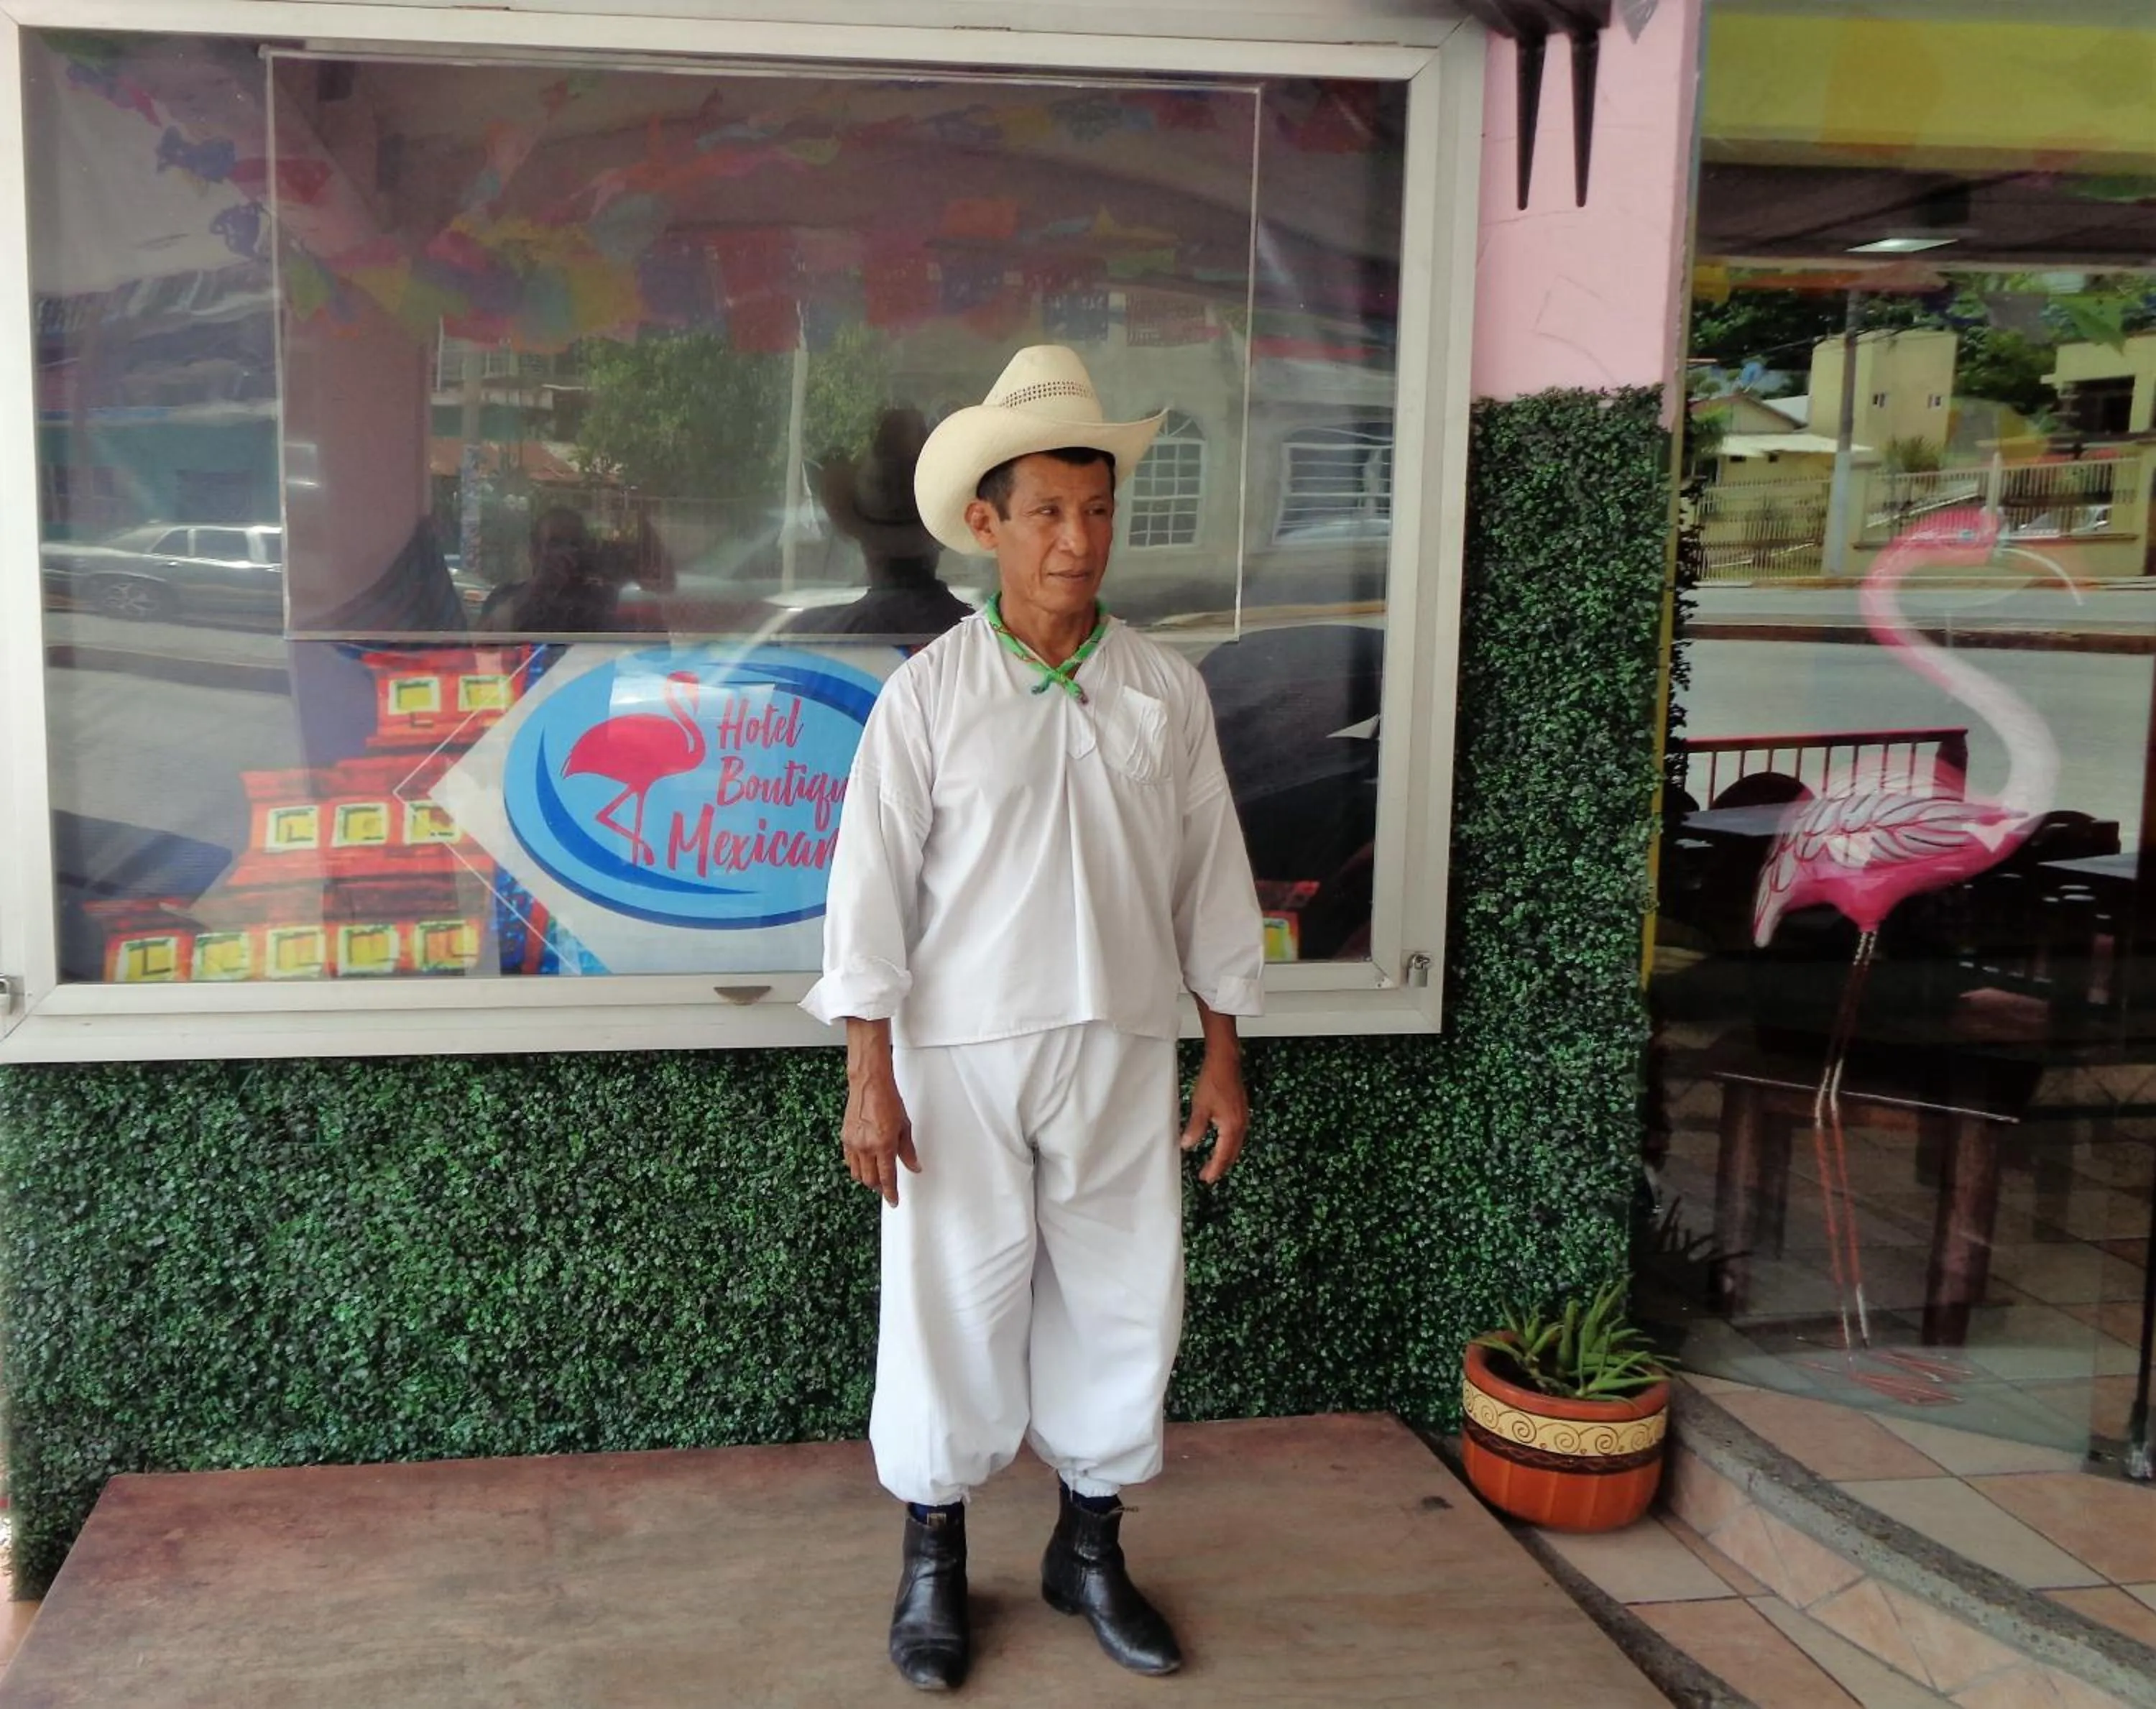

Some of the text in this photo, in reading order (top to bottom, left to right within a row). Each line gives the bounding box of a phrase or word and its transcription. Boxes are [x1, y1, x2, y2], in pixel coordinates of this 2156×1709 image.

[718, 697, 803, 750] Hotel
[718, 756, 849, 832] Boutiqu
[668, 803, 839, 877] Mexican
